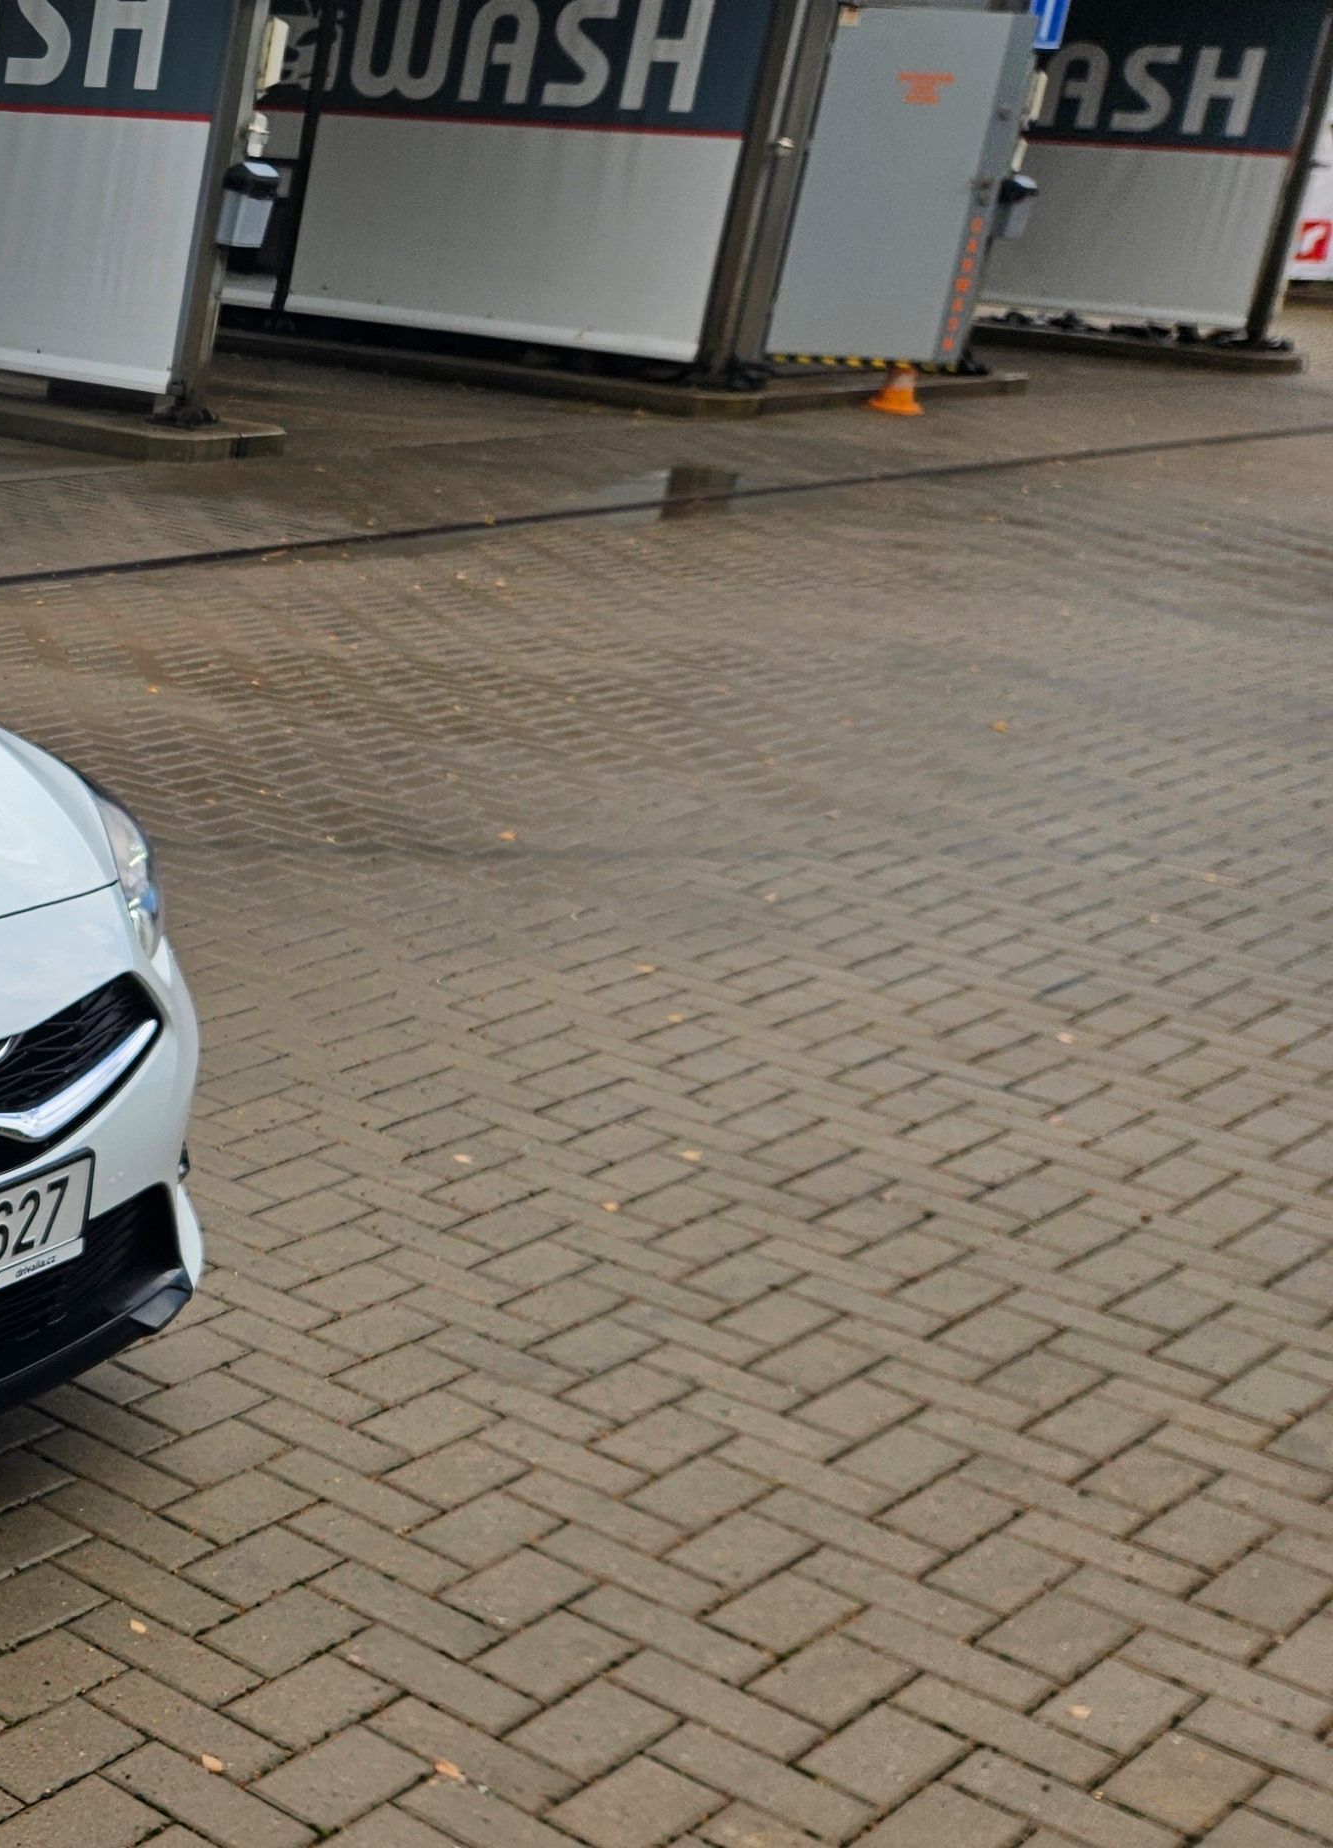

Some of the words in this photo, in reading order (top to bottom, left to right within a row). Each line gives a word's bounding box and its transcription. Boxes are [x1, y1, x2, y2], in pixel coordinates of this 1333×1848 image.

[350, 0, 715, 113] WASH
[1036, 42, 1265, 137] ASH
[15, 1255, 57, 1278] drivalia.cz
